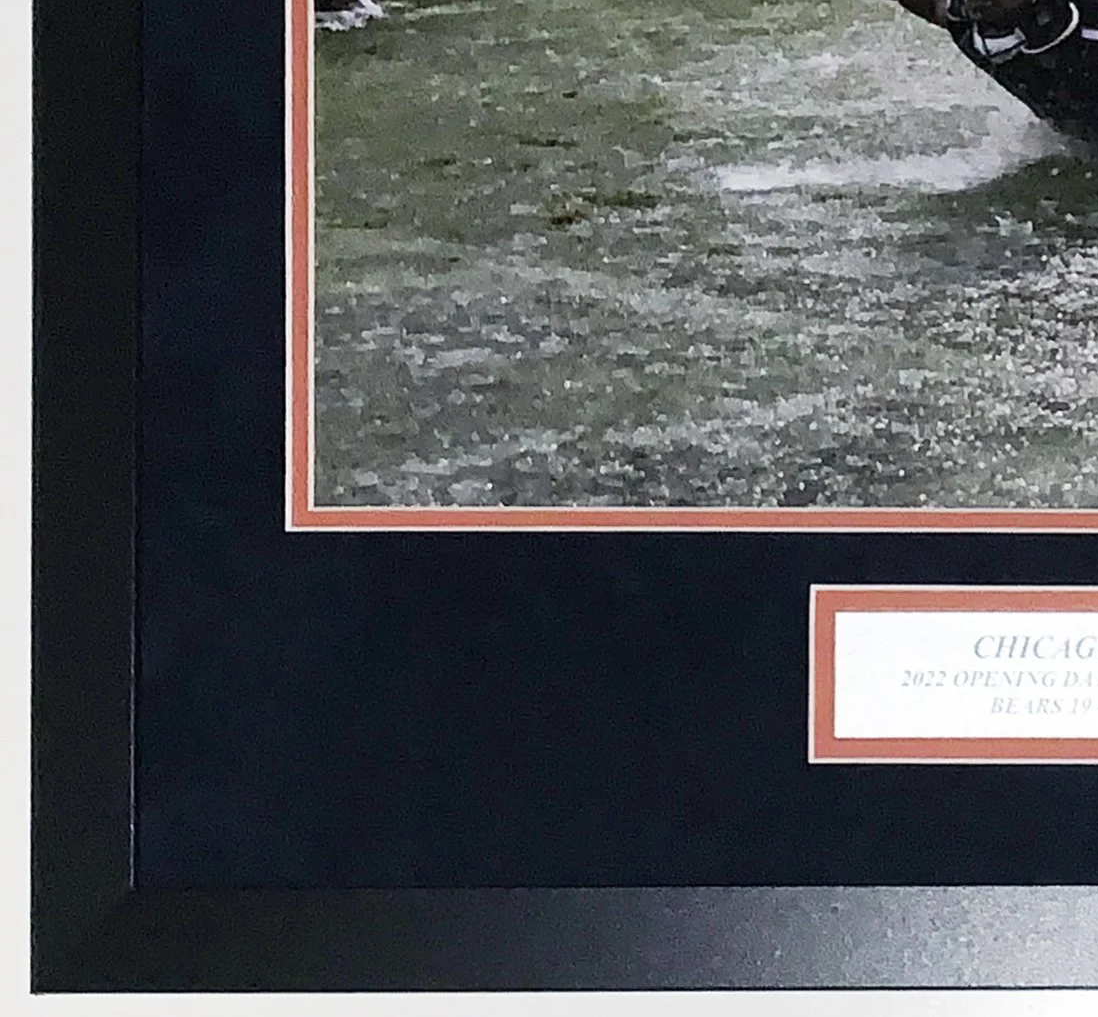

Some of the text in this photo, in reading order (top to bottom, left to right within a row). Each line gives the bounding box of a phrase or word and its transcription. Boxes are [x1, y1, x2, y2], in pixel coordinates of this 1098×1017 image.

[901, 670, 947, 689] 2022
[953, 670, 1056, 689] OPENING
[990, 696, 1063, 716] BEARS
[1070, 696, 1093, 716] 19
